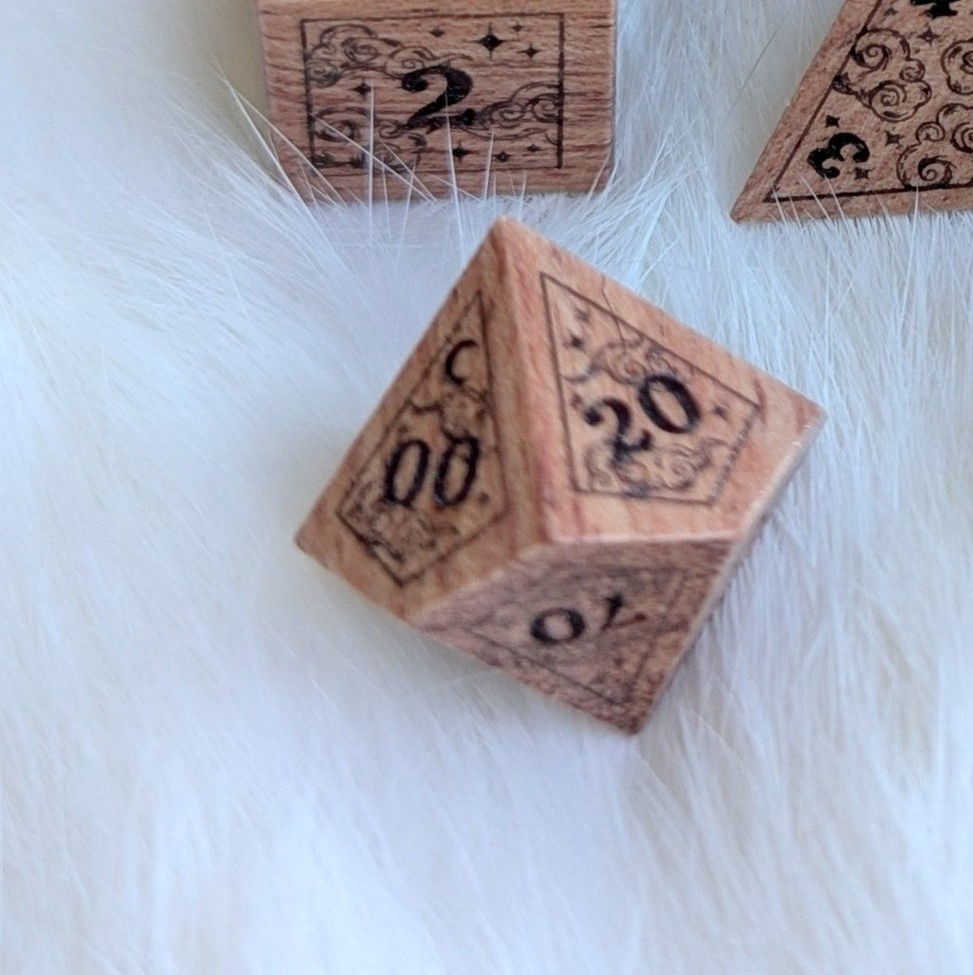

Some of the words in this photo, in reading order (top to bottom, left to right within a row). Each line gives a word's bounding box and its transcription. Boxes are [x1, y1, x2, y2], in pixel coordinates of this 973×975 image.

[401, 63, 476, 128] 2
[808, 131, 871, 179] 3
[584, 374, 701, 473] 20
[384, 434, 481, 509] 00
